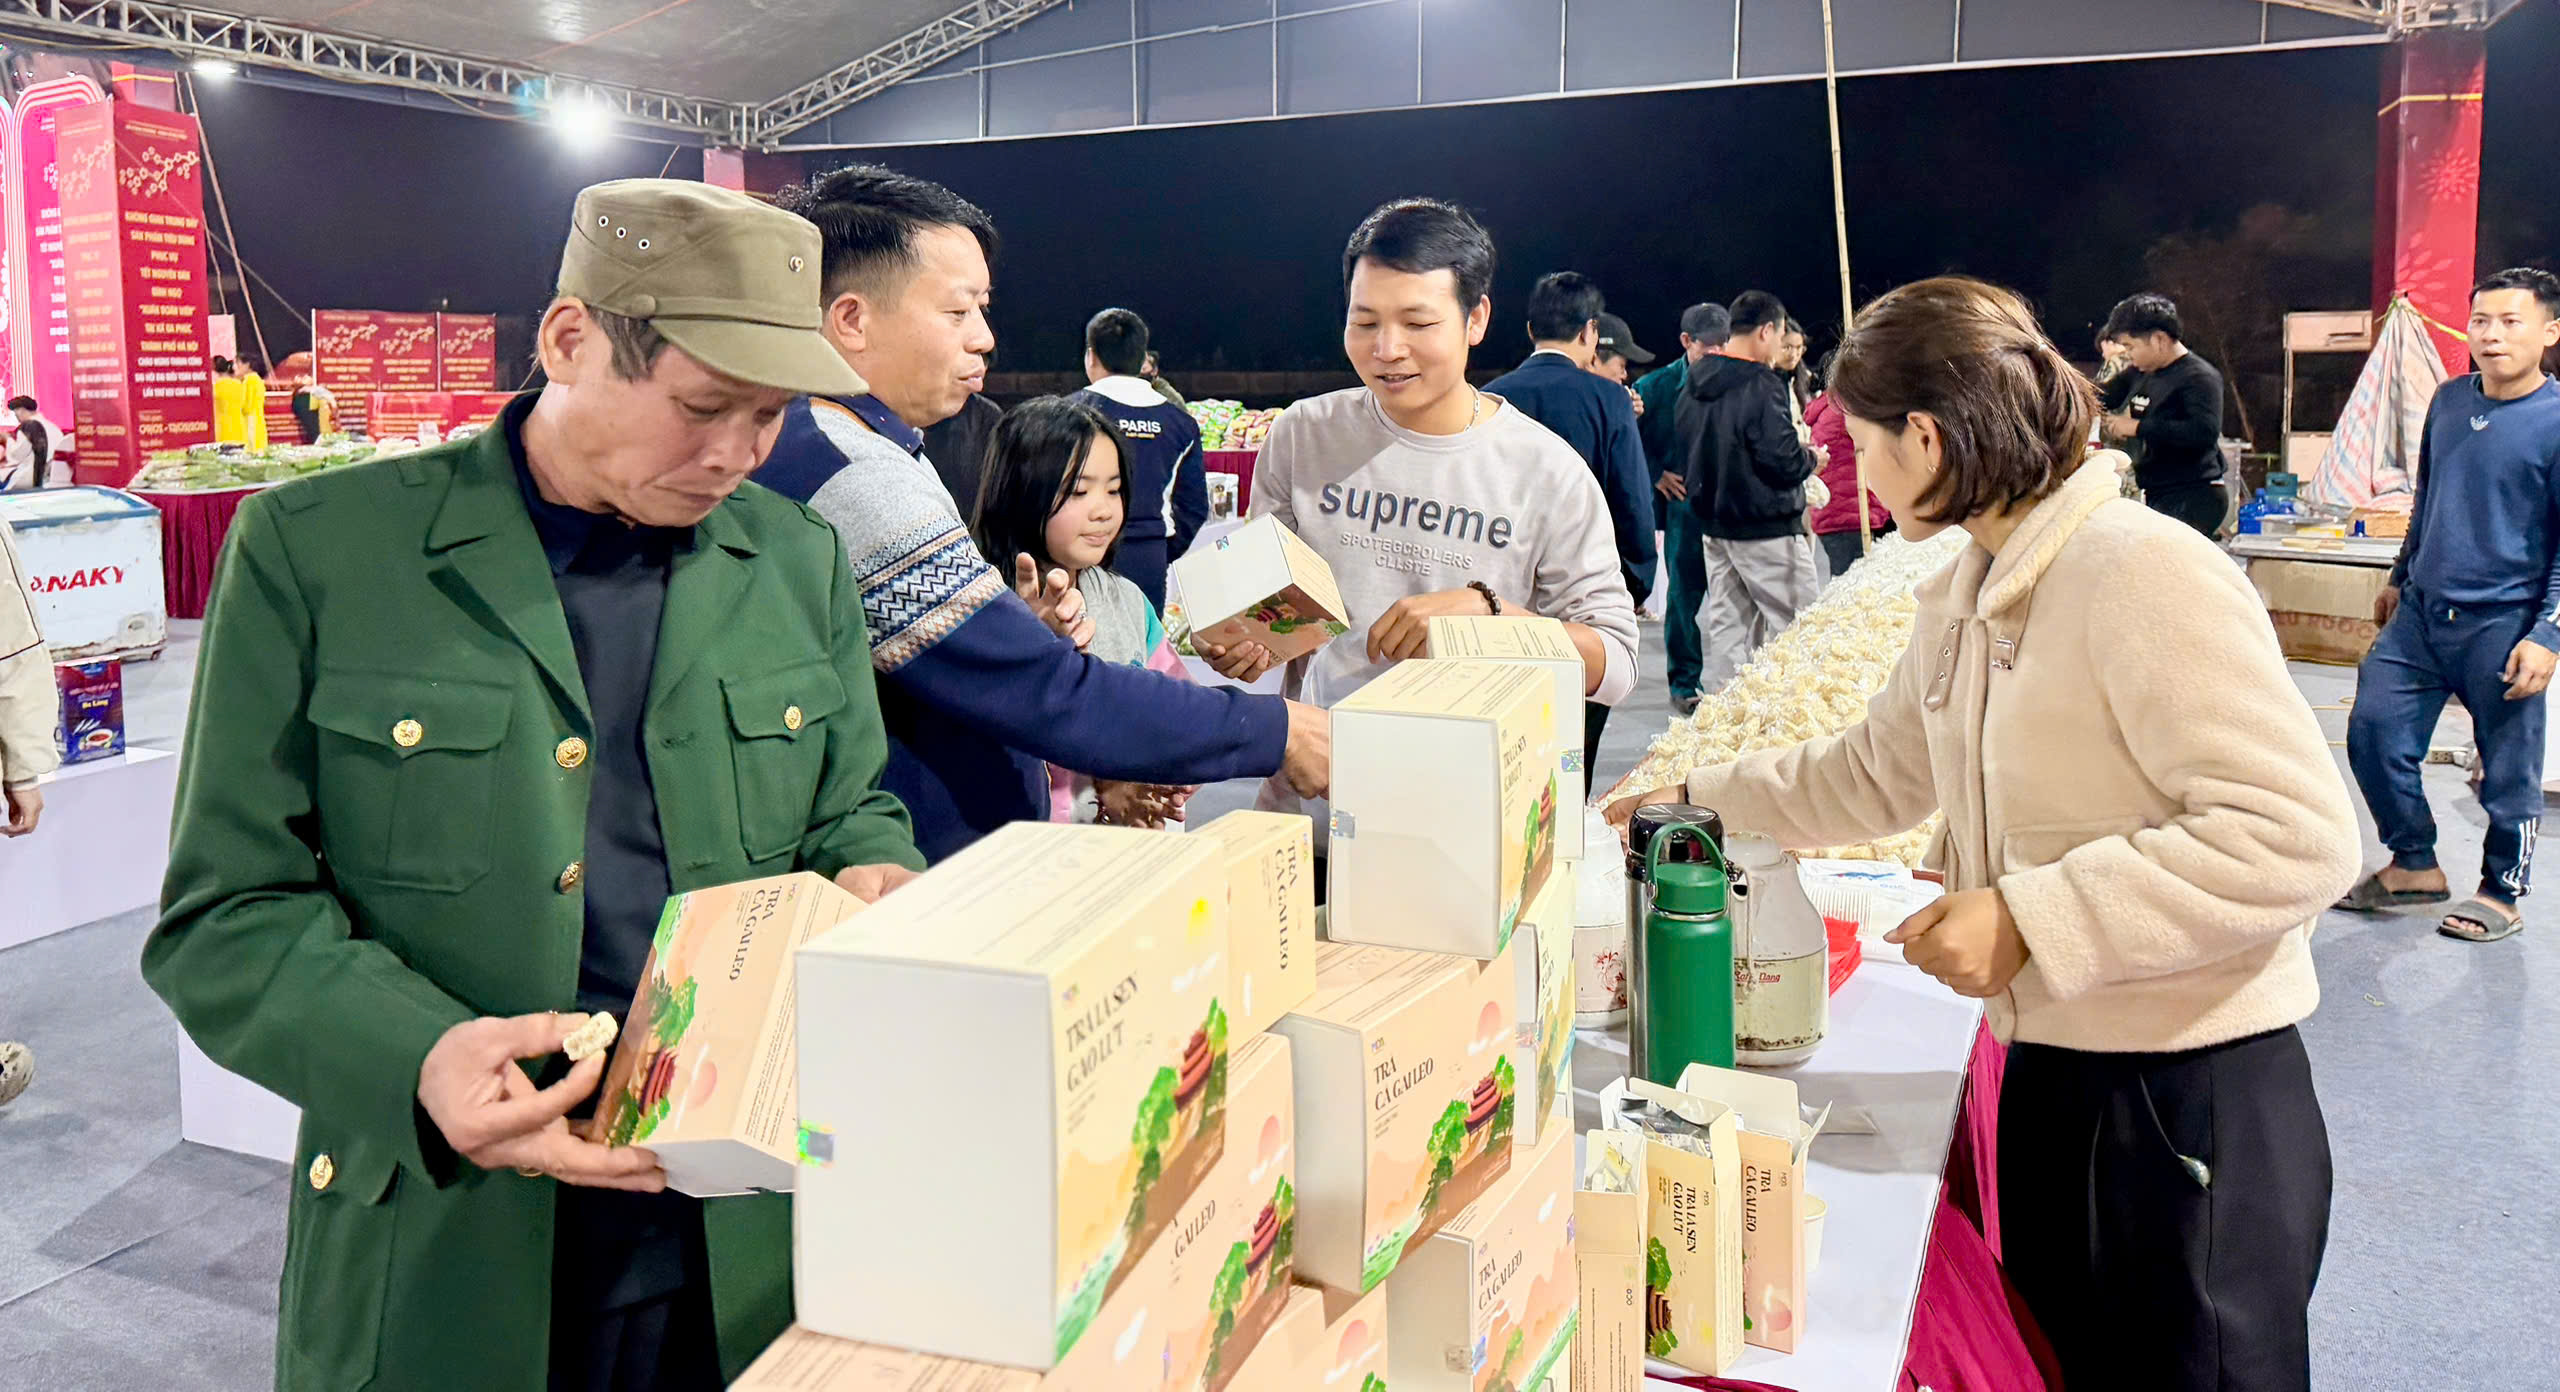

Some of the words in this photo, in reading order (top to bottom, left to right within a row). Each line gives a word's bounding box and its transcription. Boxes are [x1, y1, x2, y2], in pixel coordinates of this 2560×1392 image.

[1119, 419, 1162, 433] PARIS
[1318, 482, 1514, 549] supreme
[1373, 1056, 1397, 1085] TRA
[1375, 1087, 1392, 1111] CA
[1412, 1057, 1434, 1085] LEO
[1746, 1165, 1757, 1182] CA
[1761, 1169, 1772, 1192] TRA
[1673, 1182, 1683, 1209] GAO
[1687, 1187, 1696, 1210] TRA
[1673, 1210, 1684, 1235] LUT
[1687, 1211, 1696, 1226] LA
[1746, 1207, 1757, 1232] LEO
[1687, 1227, 1697, 1254] SEN
[1479, 1258, 1497, 1286] TRA
